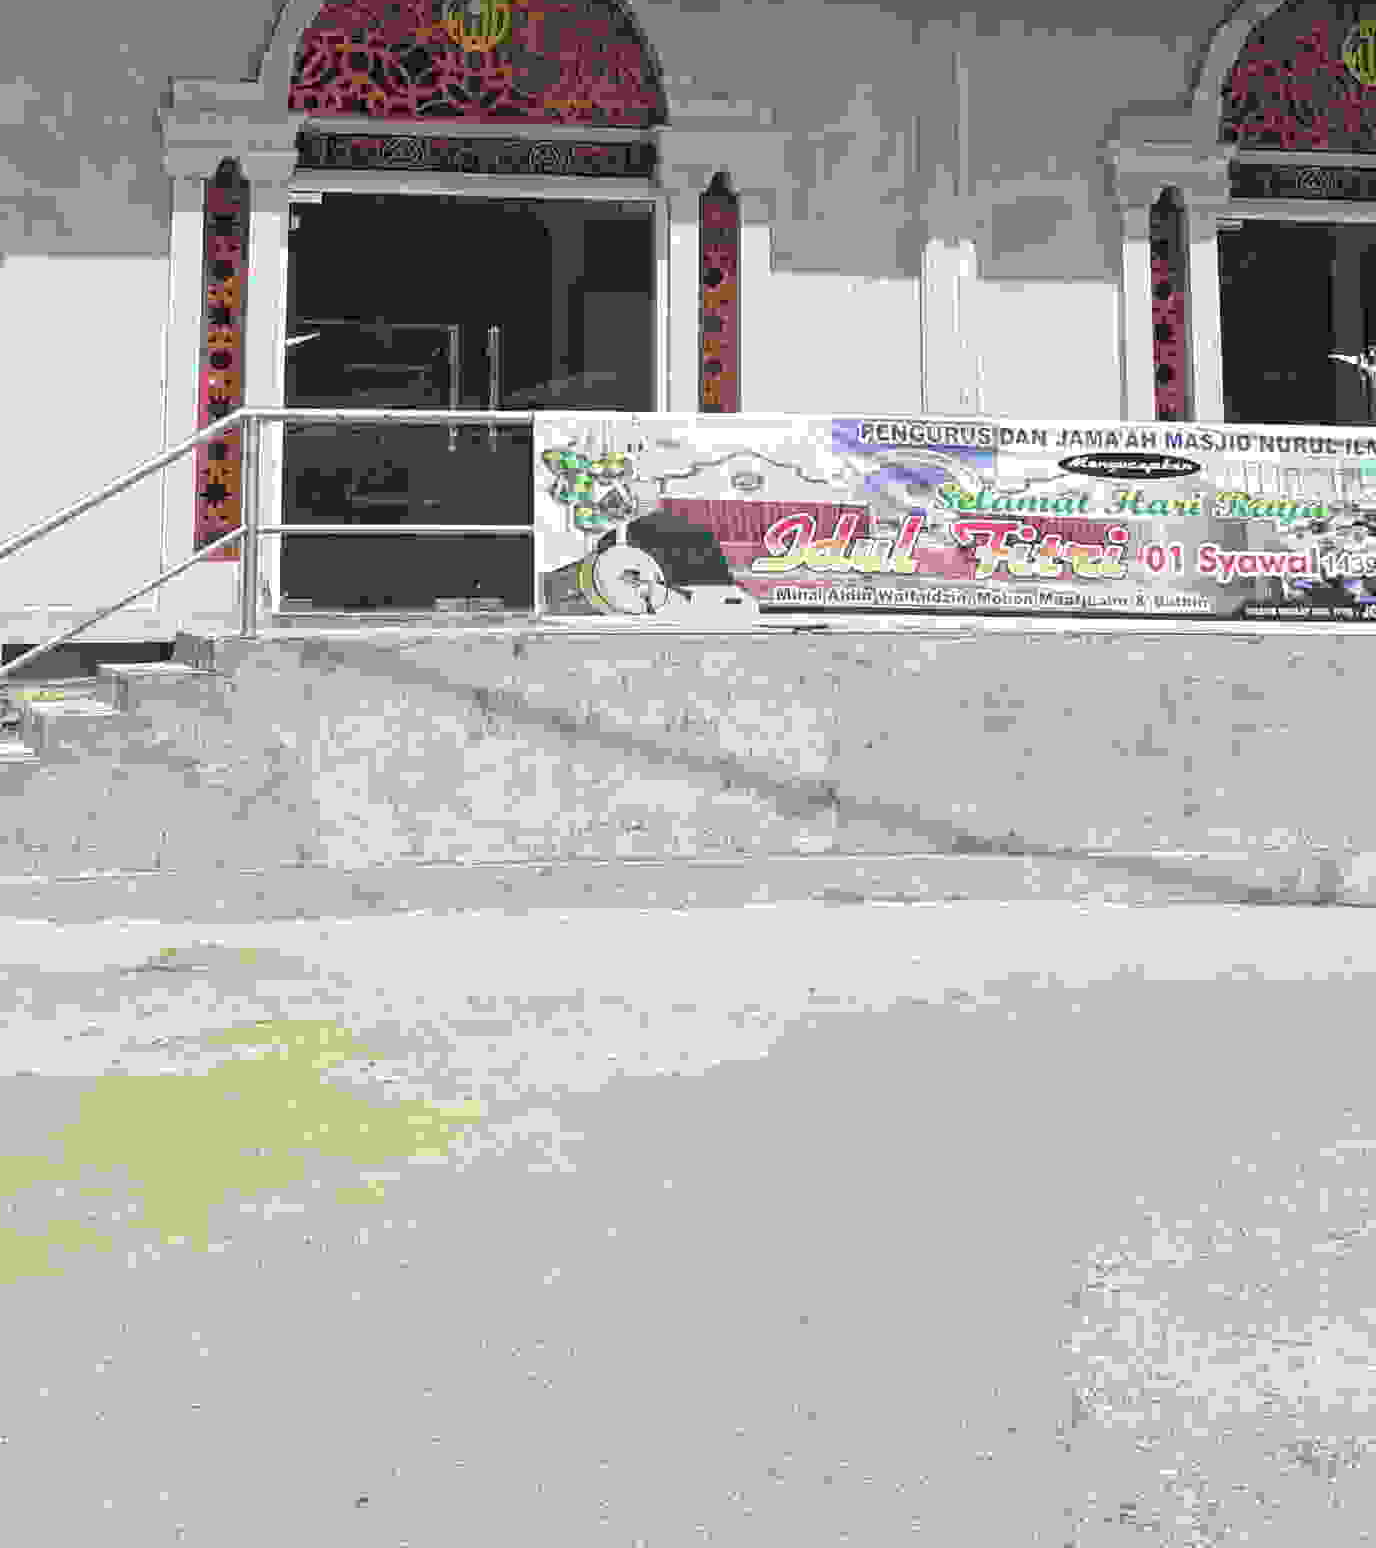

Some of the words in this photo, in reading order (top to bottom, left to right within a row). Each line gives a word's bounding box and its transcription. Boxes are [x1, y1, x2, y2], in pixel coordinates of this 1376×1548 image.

[861, 423, 992, 446] PENGURUS
[999, 426, 1048, 447] DAN
[1055, 429, 1158, 449] JAMA'AH
[1165, 431, 1250, 453] MASJID
[1258, 435, 1339, 455] NURUL
[936, 483, 1090, 519] Selamat
[1104, 483, 1202, 514] Hari
[1212, 489, 1330, 523] Raya
[751, 513, 925, 574] Idul
[949, 518, 1130, 579] Fitri
[1144, 544, 1184, 574] 01
[1199, 544, 1319, 583] Syawal
